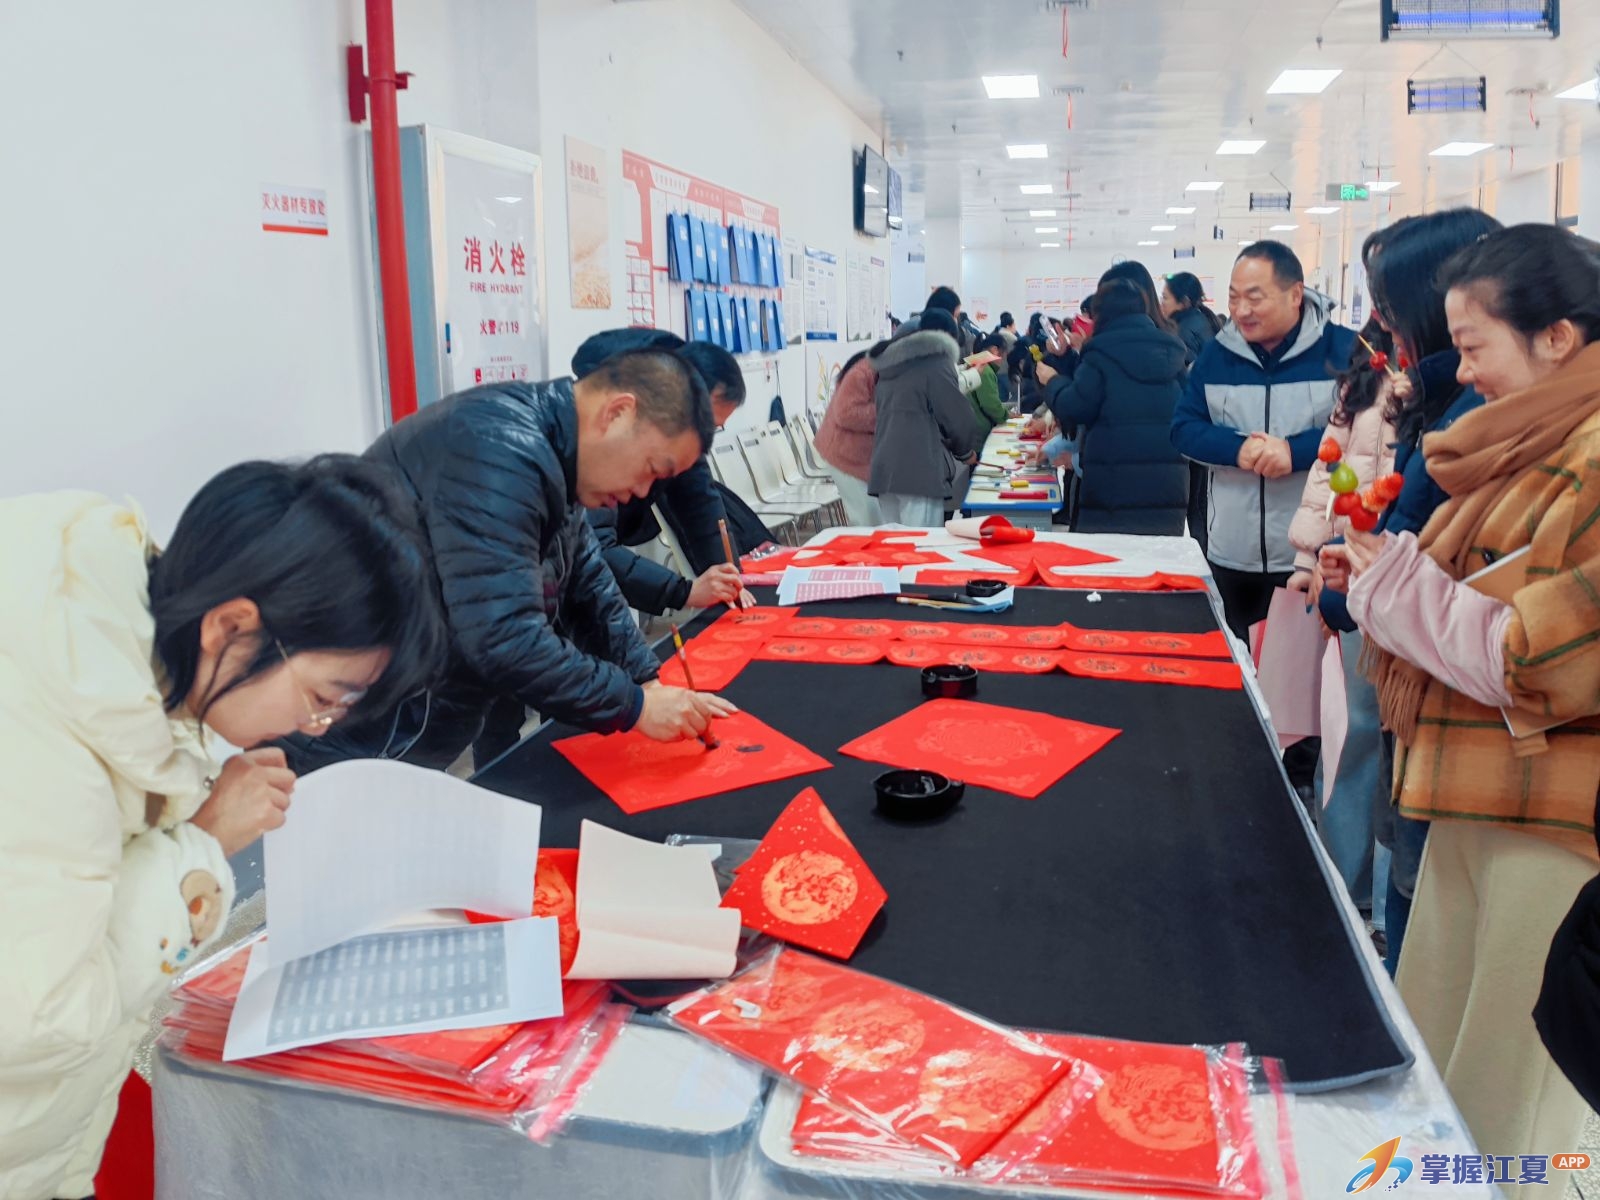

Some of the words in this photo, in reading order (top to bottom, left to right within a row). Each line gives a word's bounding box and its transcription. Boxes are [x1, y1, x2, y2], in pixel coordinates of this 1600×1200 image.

[464, 236, 526, 276] 消火栓
[470, 281, 487, 292] FIRE
[490, 283, 523, 294] HYDRANT
